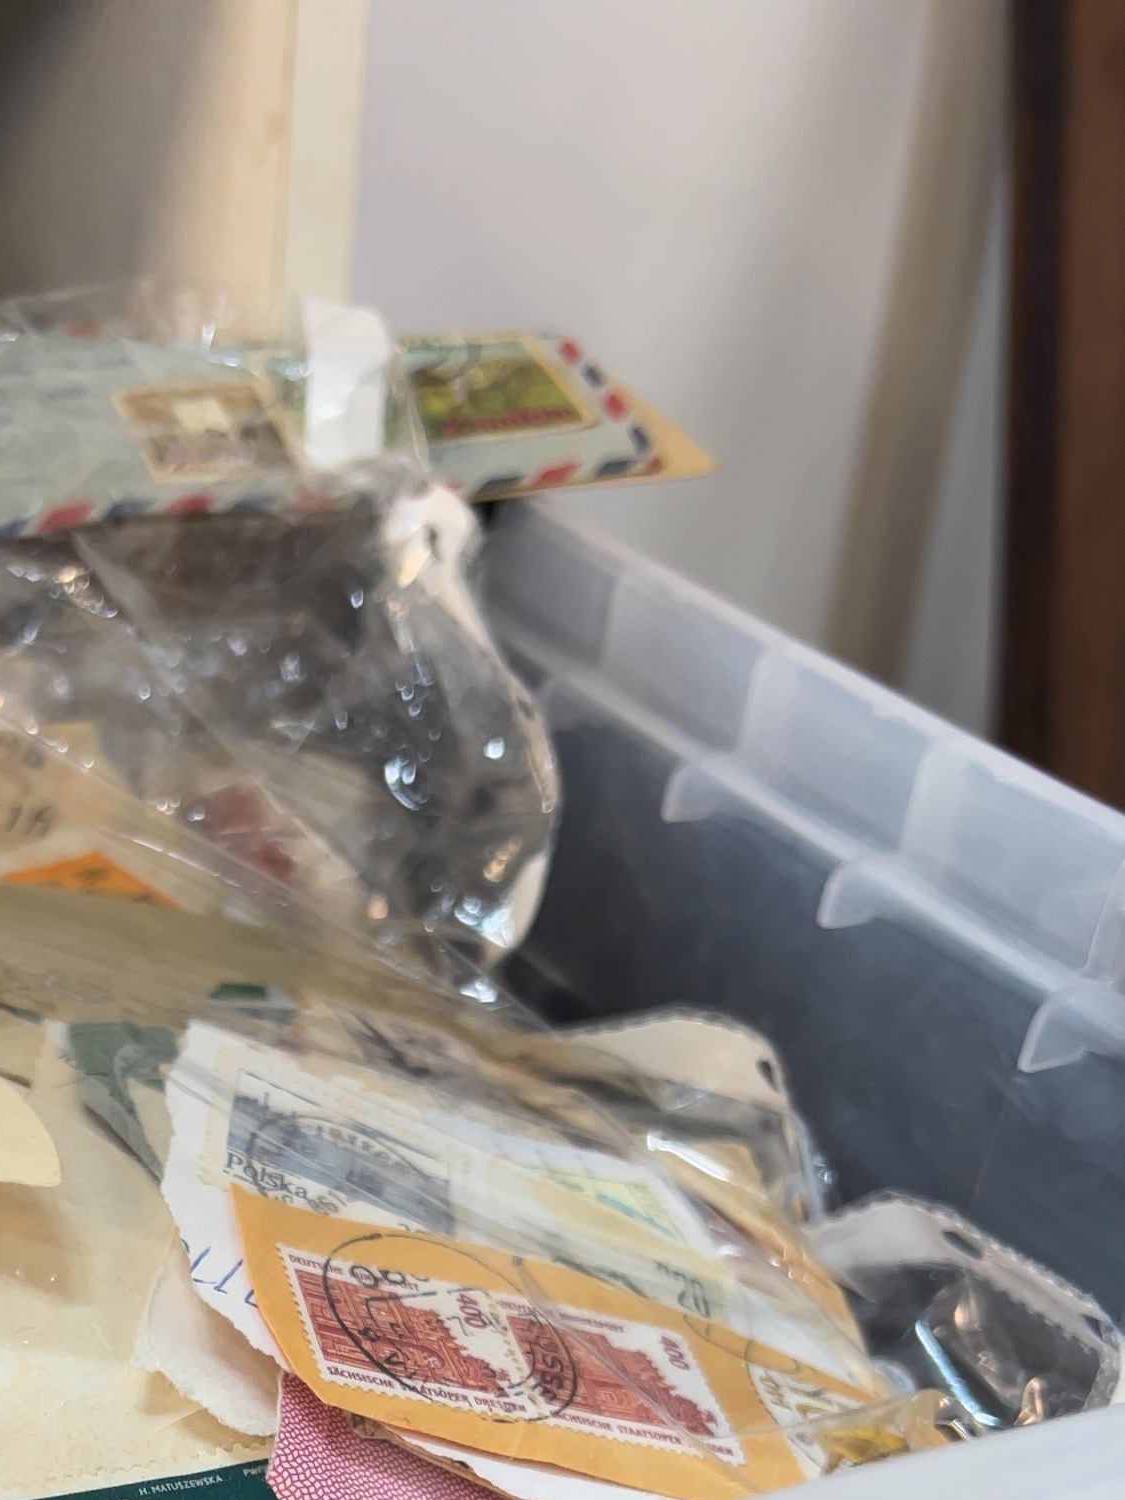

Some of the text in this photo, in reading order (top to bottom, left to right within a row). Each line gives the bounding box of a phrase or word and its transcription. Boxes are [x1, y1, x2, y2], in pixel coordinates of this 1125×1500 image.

[227, 1153, 308, 1197] Polska
[659, 1334, 691, 1371] 400
[326, 1365, 396, 1390] SÄCHSISCHE
[399, 1381, 473, 1406] SATSOPER
[151, 1474, 225, 1494] MATUSZEWSKA
